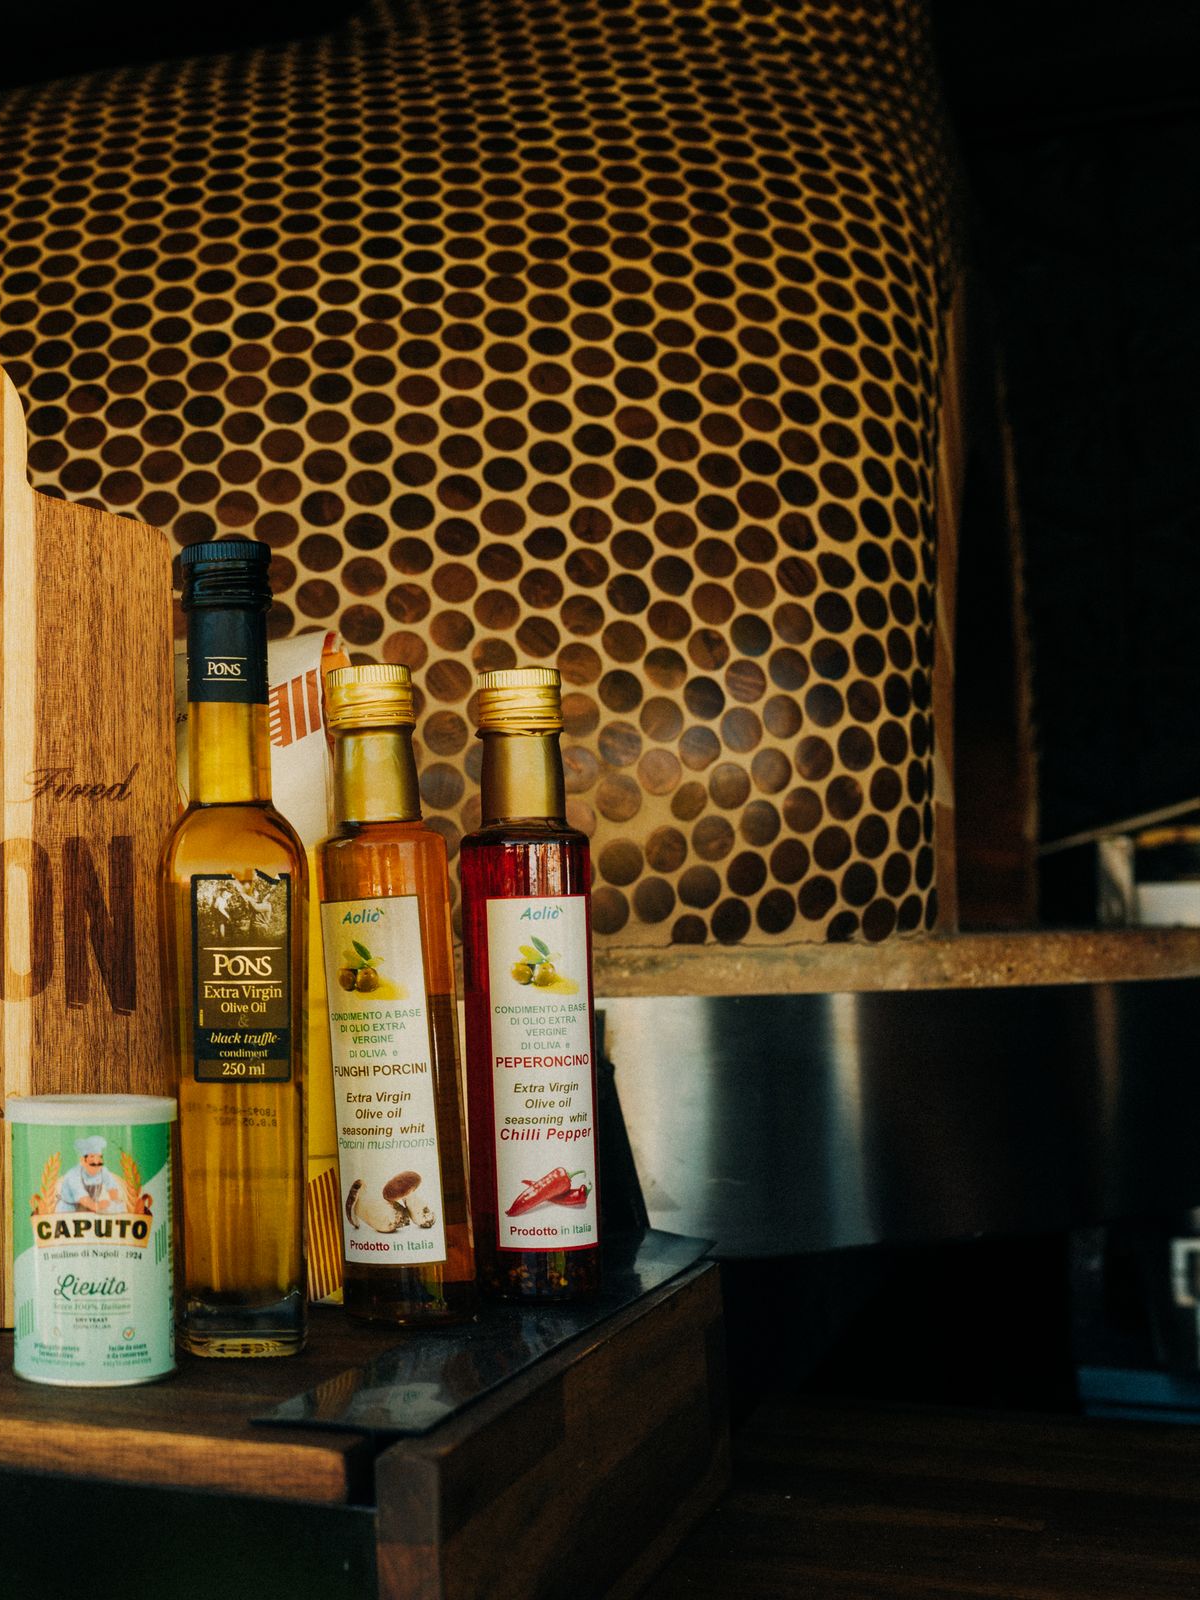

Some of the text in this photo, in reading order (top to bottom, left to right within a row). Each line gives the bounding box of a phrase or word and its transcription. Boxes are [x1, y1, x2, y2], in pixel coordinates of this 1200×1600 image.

[207, 661, 241, 676] PONS
[7, 762, 140, 804] Fired
[212, 953, 273, 977] PONS
[204, 985, 282, 1001] Extra Virgin
[221, 1001, 267, 1013] Olive Oil
[495, 1005, 558, 1014] CONDIMENTO
[568, 1003, 586, 1012] BASE
[385, 1011, 392, 1019] A
[394, 1008, 421, 1018] BASE
[238, 1015, 249, 1027] &
[510, 1015, 576, 1025] DI OLIO EXTRA
[340, 1022, 406, 1032] DI OLIO EXTRA
[526, 1028, 567, 1036] VERGINE
[352, 1034, 394, 1044] VERGINE
[521, 1042, 530, 1050] DI
[533, 1041, 561, 1050] OLIVA
[219, 1047, 268, 1058] condiment
[349, 1050, 357, 1058] DI
[359, 1049, 387, 1057] OLIVA
[496, 1053, 589, 1068] PEPERONCINO
[222, 1062, 265, 1076] 250 ml
[334, 1062, 427, 1077] FUNGHI PORCINI
[513, 1082, 579, 1095] Extra Virgin
[346, 1091, 411, 1104] Extra Virgin
[525, 1098, 571, 1109] Olive oil
[355, 1107, 402, 1119] Olive oil
[504, 1112, 587, 1126] seasoning whit
[342, 1123, 425, 1138] seasoning whit
[500, 1127, 591, 1142] Chilli Pepper
[338, 1137, 435, 1150] Porcini mushrooms
[36, 1219, 148, 1240] CAPUTO
[510, 1224, 591, 1236] Prodotto in Italia
[350, 1240, 434, 1251] Prodotto in Italia
[43, 1252, 49, 1260] Il
[51, 1251, 78, 1259] mulino
[92, 1249, 119, 1259] Napoli
[125, 1251, 142, 1260] 1924
[53, 1274, 127, 1301] Lievito
